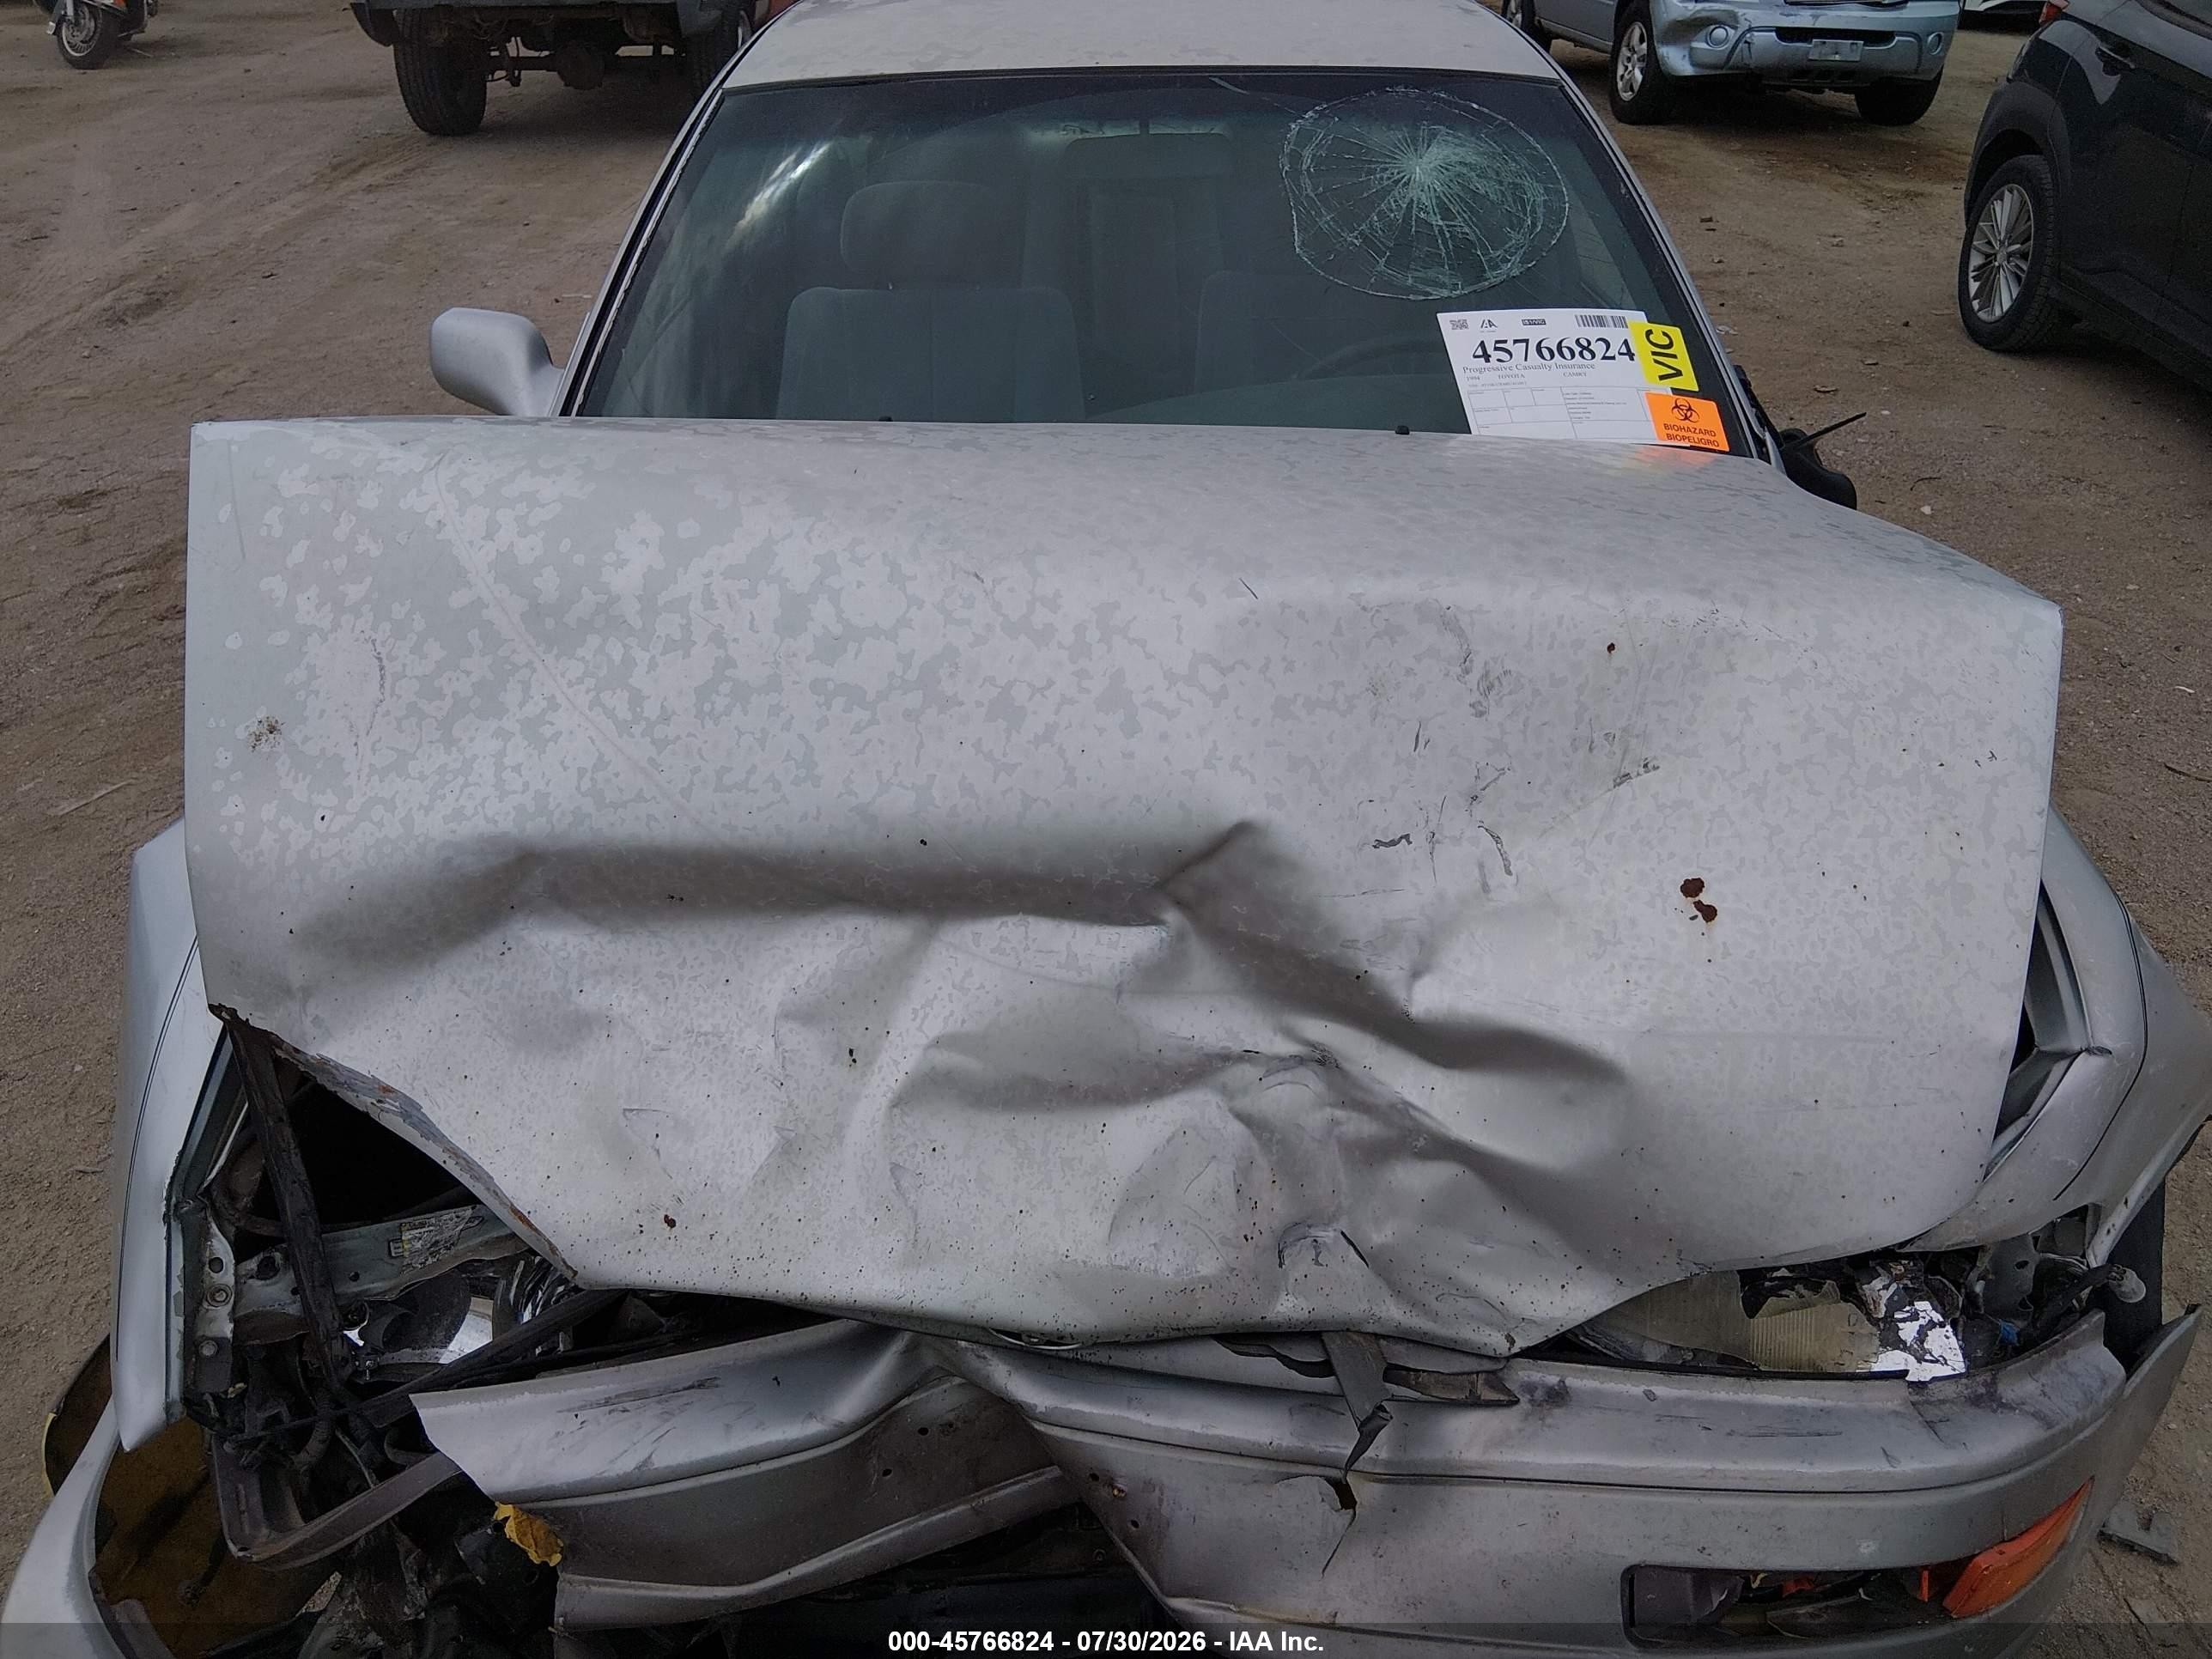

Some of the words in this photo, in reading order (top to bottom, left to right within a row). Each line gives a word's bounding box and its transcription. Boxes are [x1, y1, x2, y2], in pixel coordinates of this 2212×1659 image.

[1472, 337, 1636, 363] 45766824
[1644, 328, 1684, 381] VIC
[1462, 364, 1513, 375] Progressive
[1515, 362, 1553, 373] Casualty
[1554, 362, 1595, 370] Insurance
[1663, 422, 1717, 437] BIOHAZARD
[1666, 433, 1719, 447] BIOPELIGRO
